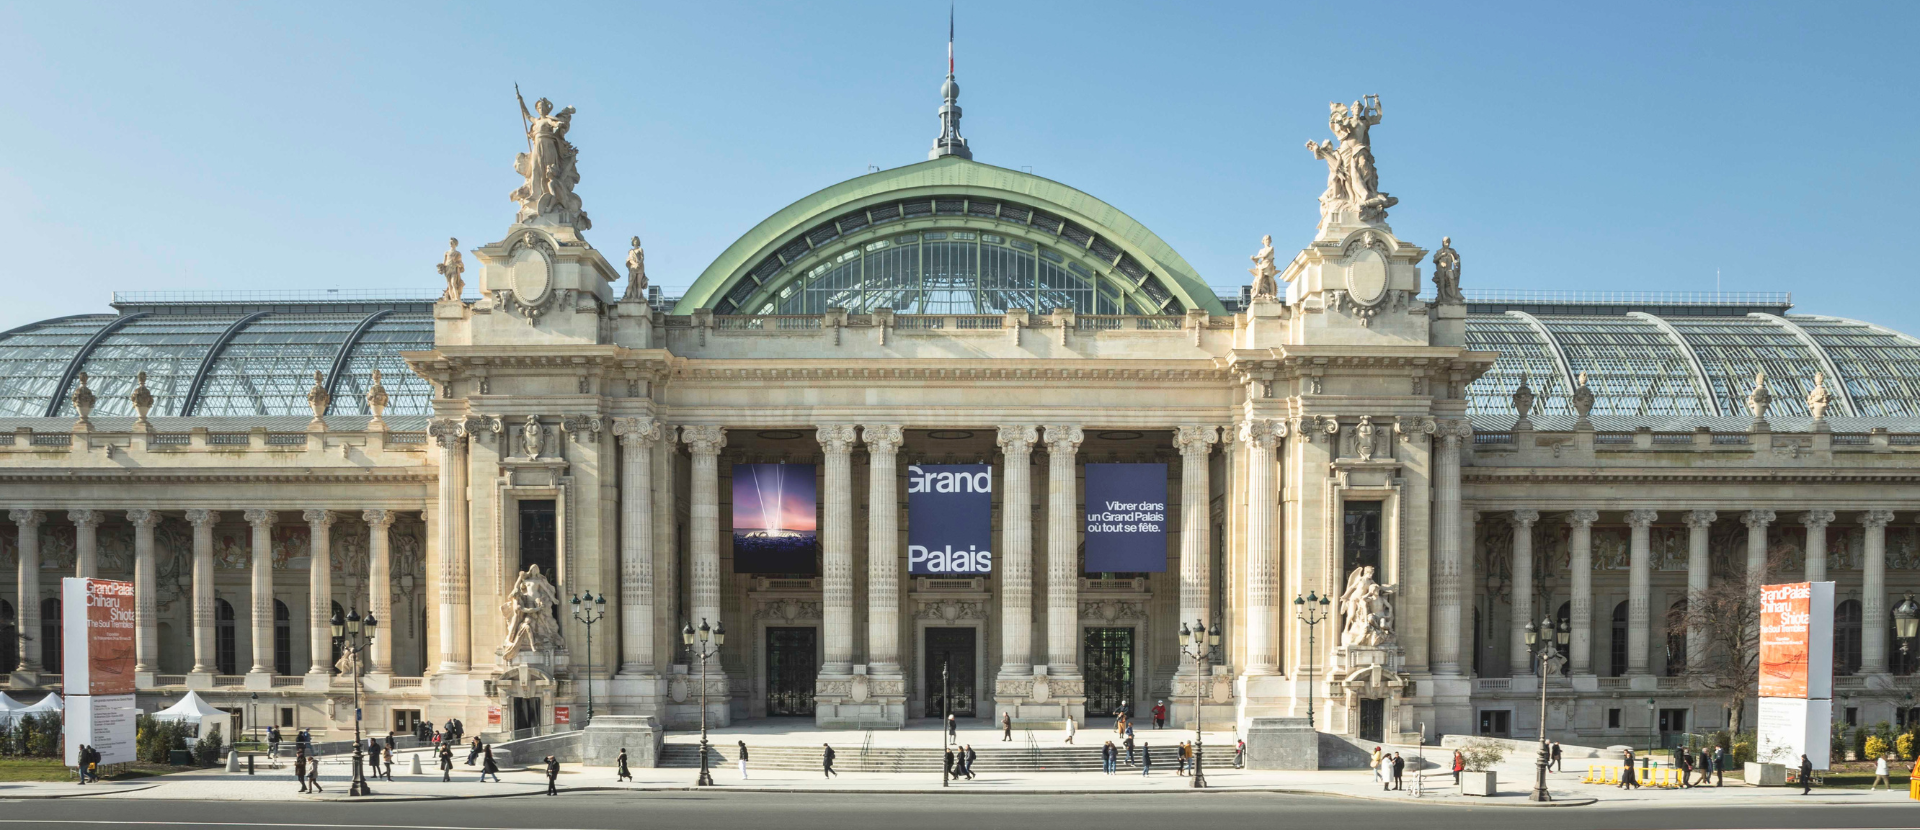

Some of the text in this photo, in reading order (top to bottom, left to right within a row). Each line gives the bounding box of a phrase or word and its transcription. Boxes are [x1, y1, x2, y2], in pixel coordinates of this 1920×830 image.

[908, 466, 992, 493] Grand
[1106, 501, 1164, 510] Vibrer dans
[1102, 512, 1134, 521] Grand
[1134, 512, 1164, 521] Palais
[1088, 523, 1101, 532] où
[1102, 523, 1123, 532] tout
[1138, 522, 1160, 532] fête.
[908, 545, 992, 572] Palais
[87, 594, 120, 607] Chiharu
[99, 620, 110, 628] Soul
[111, 620, 133, 628] Trembles
[1781, 612, 1810, 625] Shiota
